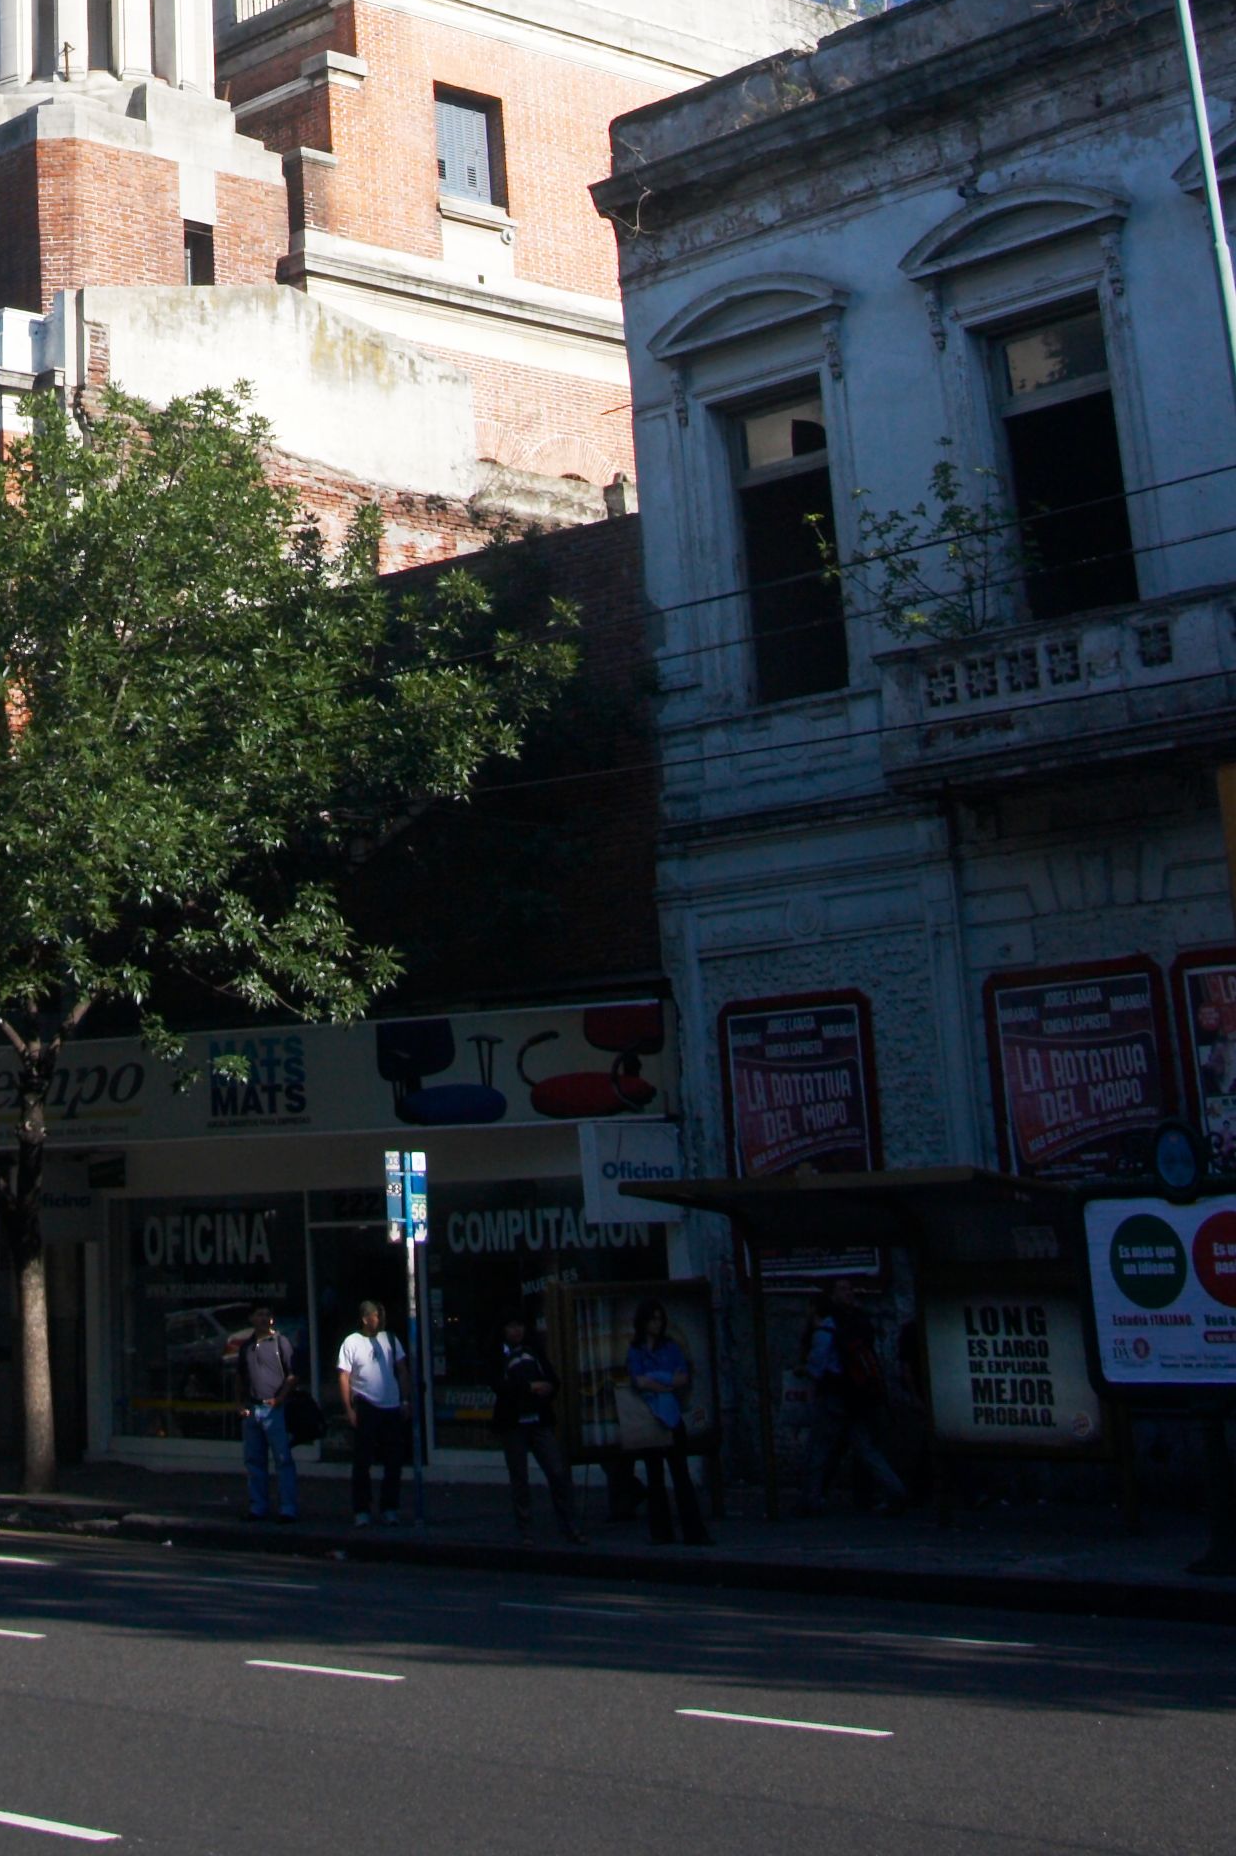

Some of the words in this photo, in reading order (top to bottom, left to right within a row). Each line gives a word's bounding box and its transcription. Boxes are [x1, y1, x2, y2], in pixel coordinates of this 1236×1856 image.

[1016, 1045, 1044, 1092] LA
[211, 1083, 307, 1116] MATS
[743, 1068, 767, 1112] LA
[1040, 1088, 1083, 1128] DEL
[1088, 1077, 1143, 1114] MAIPO
[762, 1109, 799, 1144] DEL
[801, 1100, 848, 1134] MAIPO
[601, 1161, 674, 1180] Oficina
[39, 1191, 92, 1208] ficina
[411, 1202, 427, 1221] 56
[143, 1212, 272, 1266] OFICINA
[965, 1305, 1047, 1336] LONG
[967, 1339, 988, 1357] ES
[992, 1339, 1049, 1358] LARGO
[968, 1360, 985, 1374] DE
[988, 1360, 1052, 1374] EXPLICAR.
[971, 1378, 1054, 1406] MEJOR
[973, 1406, 1057, 1427] PROBALO.
